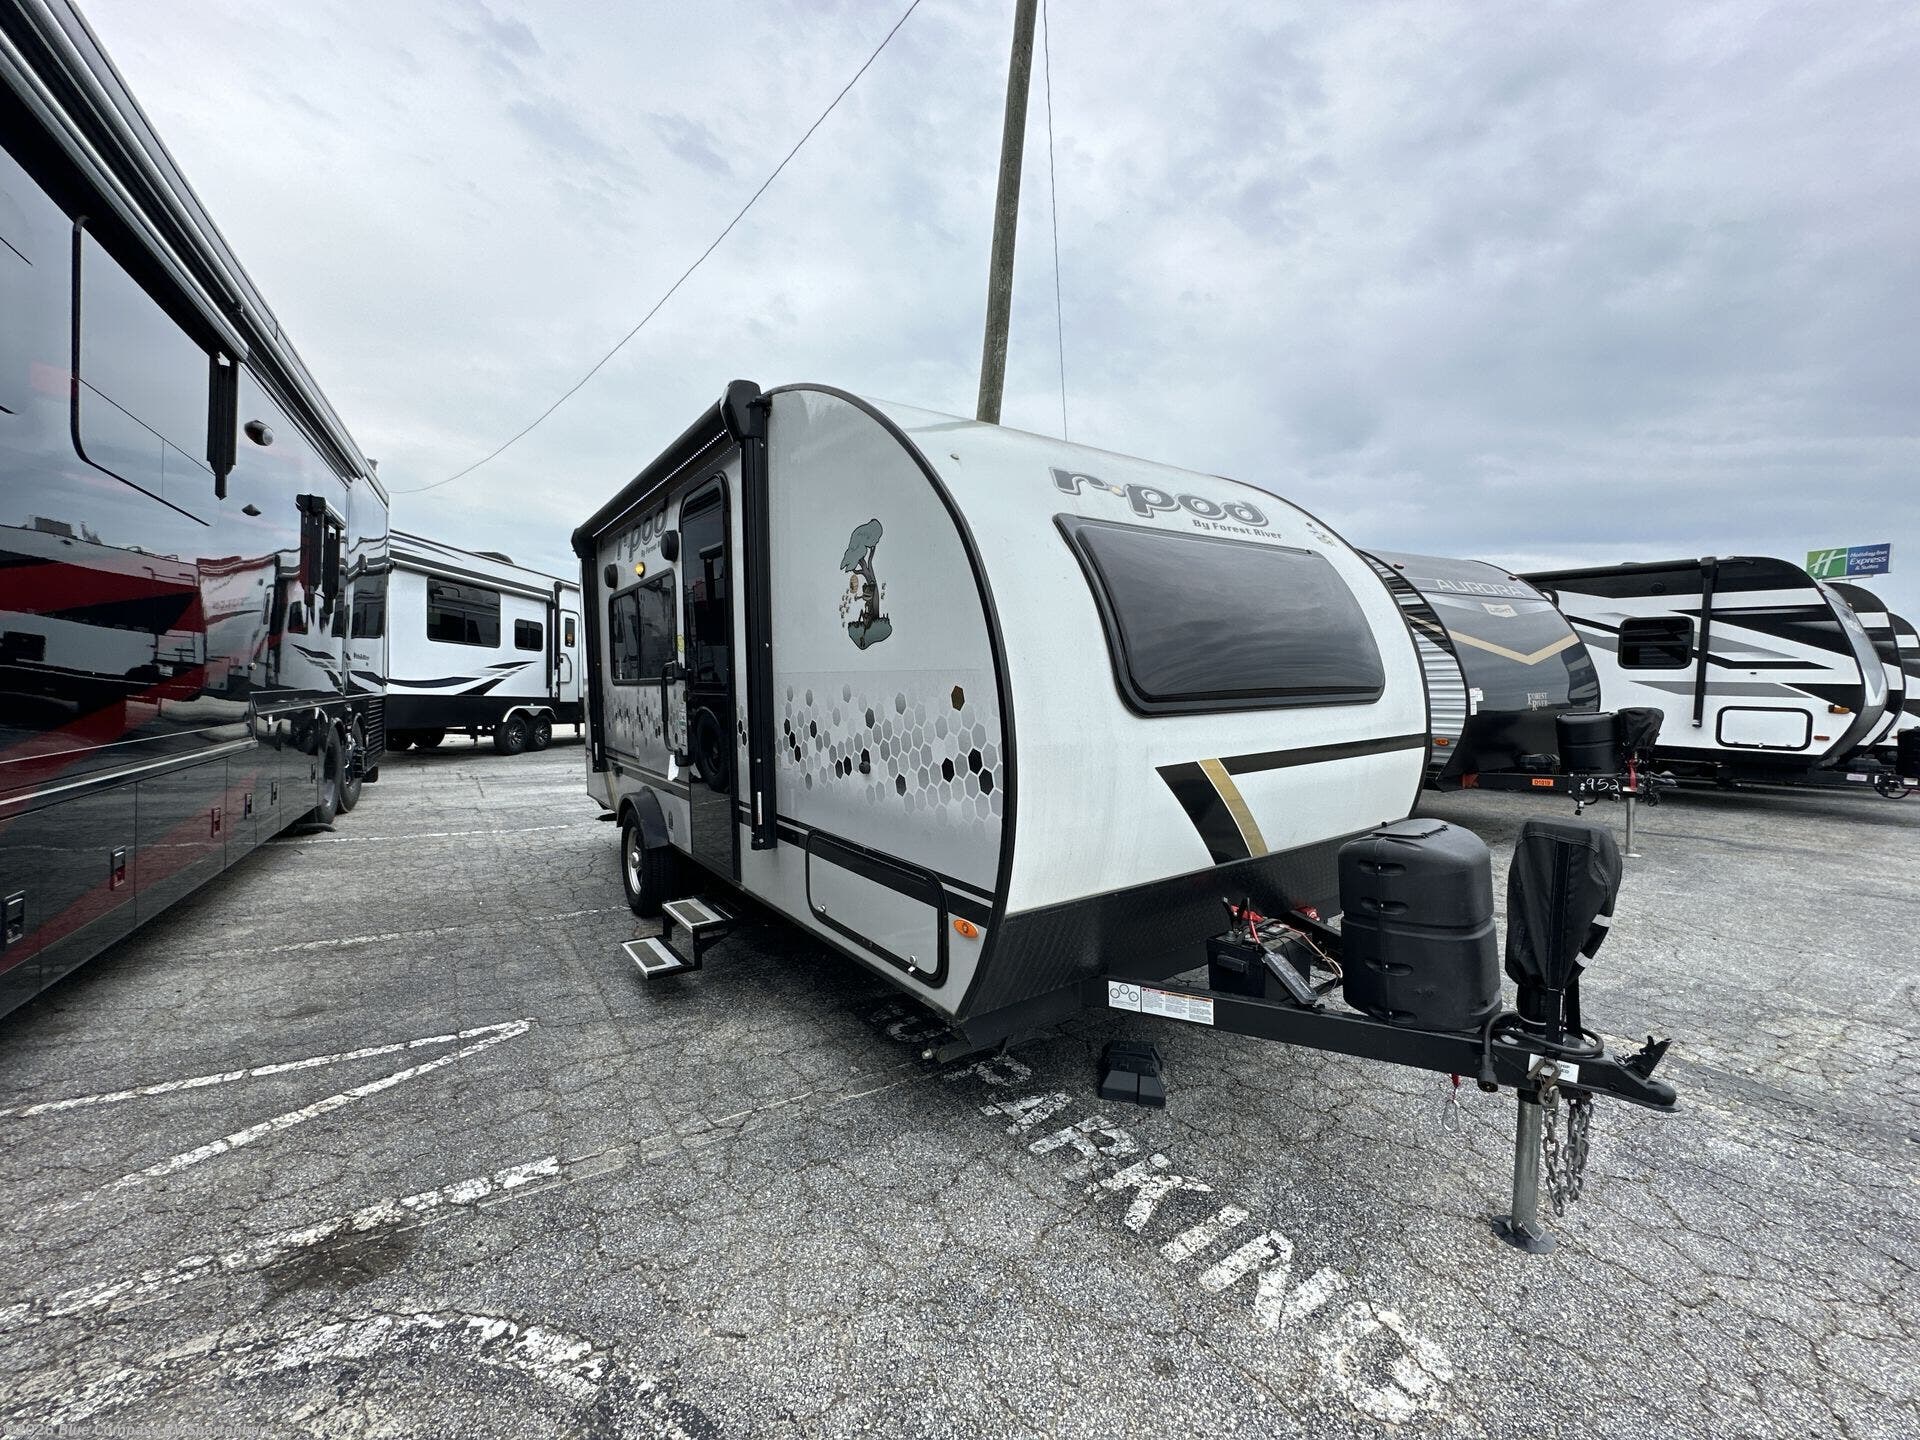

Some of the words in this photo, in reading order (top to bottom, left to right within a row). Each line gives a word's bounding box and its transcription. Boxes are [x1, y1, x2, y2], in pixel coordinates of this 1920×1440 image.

[1192, 519, 1210, 530] By
[1212, 522, 1251, 535] Forest
[1253, 528, 1282, 539] River
[1849, 556, 1887, 566] Express
[1437, 579, 1526, 597] AURORA
[1586, 777, 1620, 793] 952
[943, 1053, 1454, 1421] PARKING
